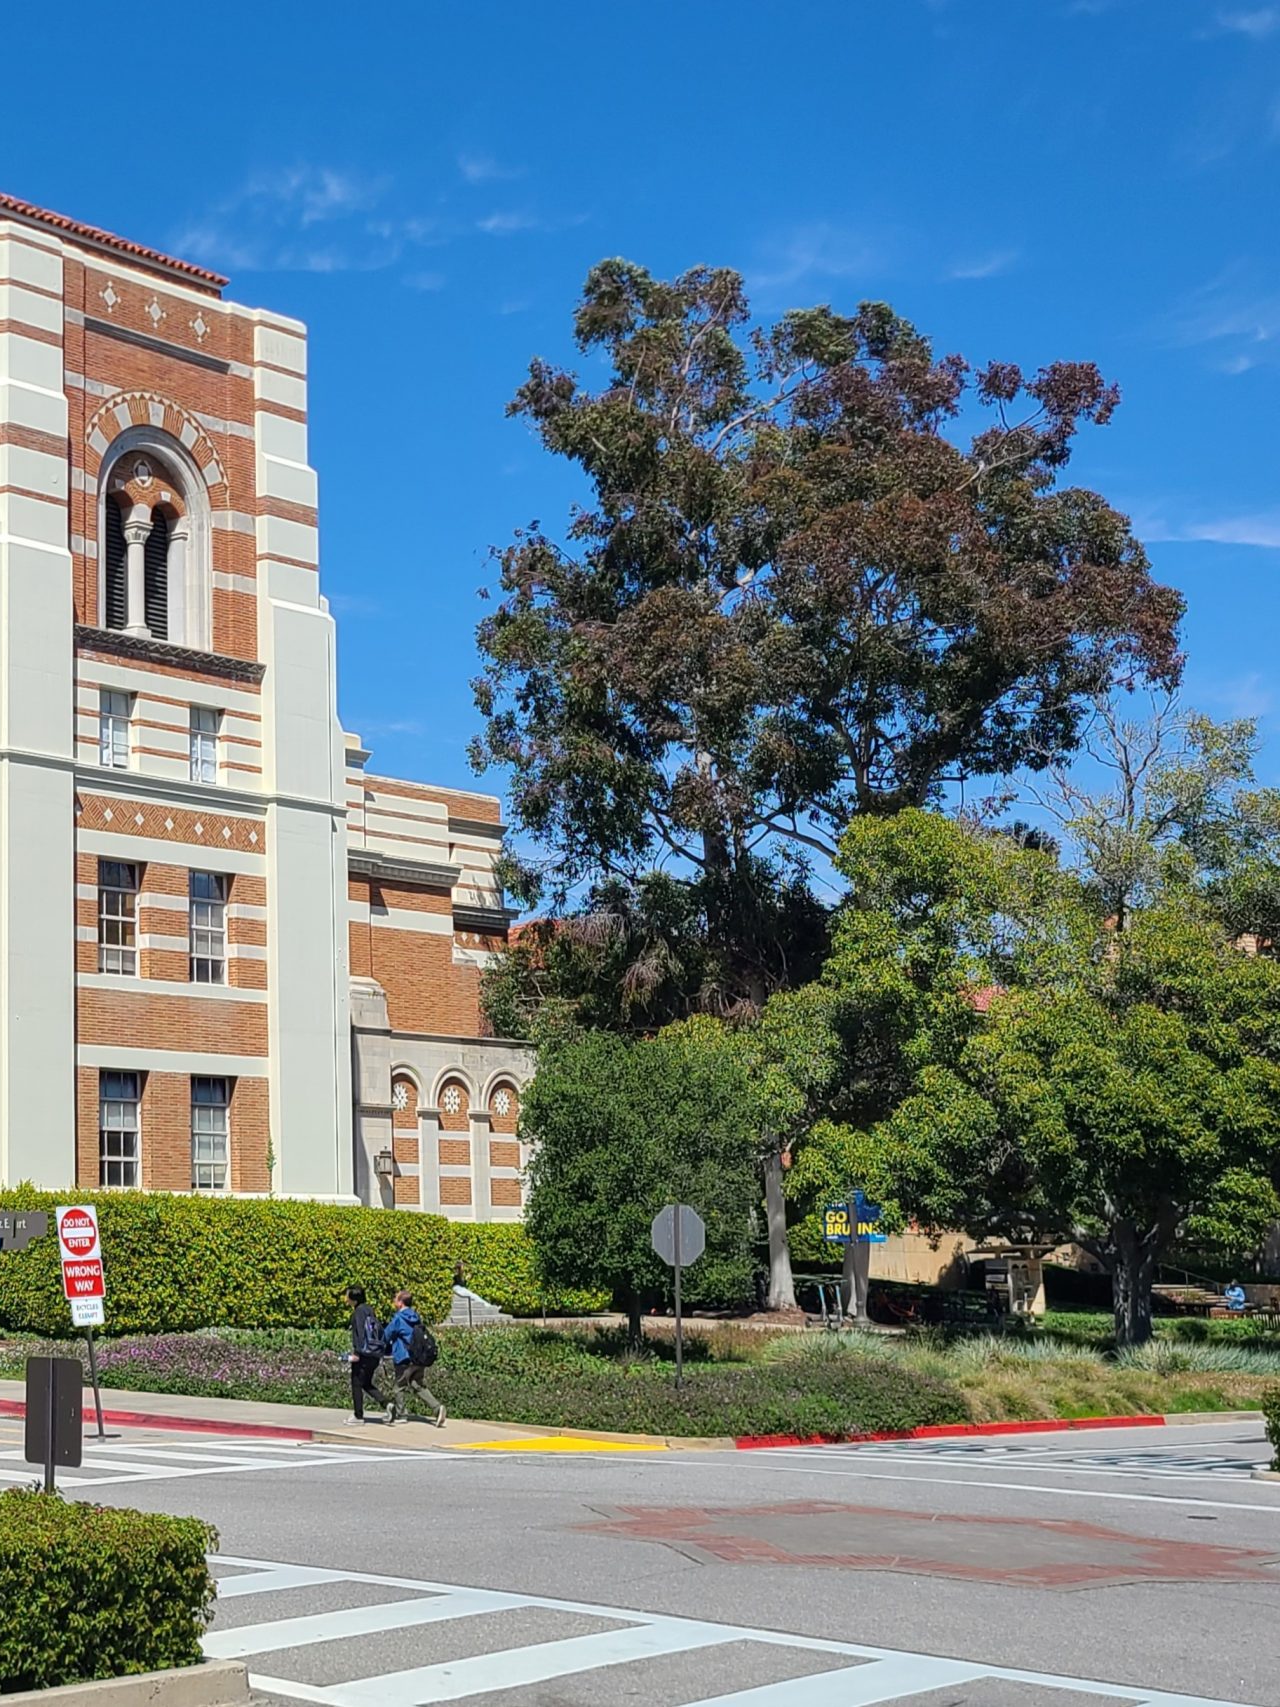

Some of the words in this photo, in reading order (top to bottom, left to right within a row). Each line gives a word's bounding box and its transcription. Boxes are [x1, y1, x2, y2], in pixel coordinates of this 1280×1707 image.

[63, 1218, 74, 1228] DO
[75, 1217, 90, 1227] NOT
[825, 1211, 848, 1223] GO
[826, 1223, 851, 1236] BRU
[68, 1238, 91, 1248] ENTER
[65, 1264, 101, 1278] WRONG
[74, 1279, 95, 1292] WAY
